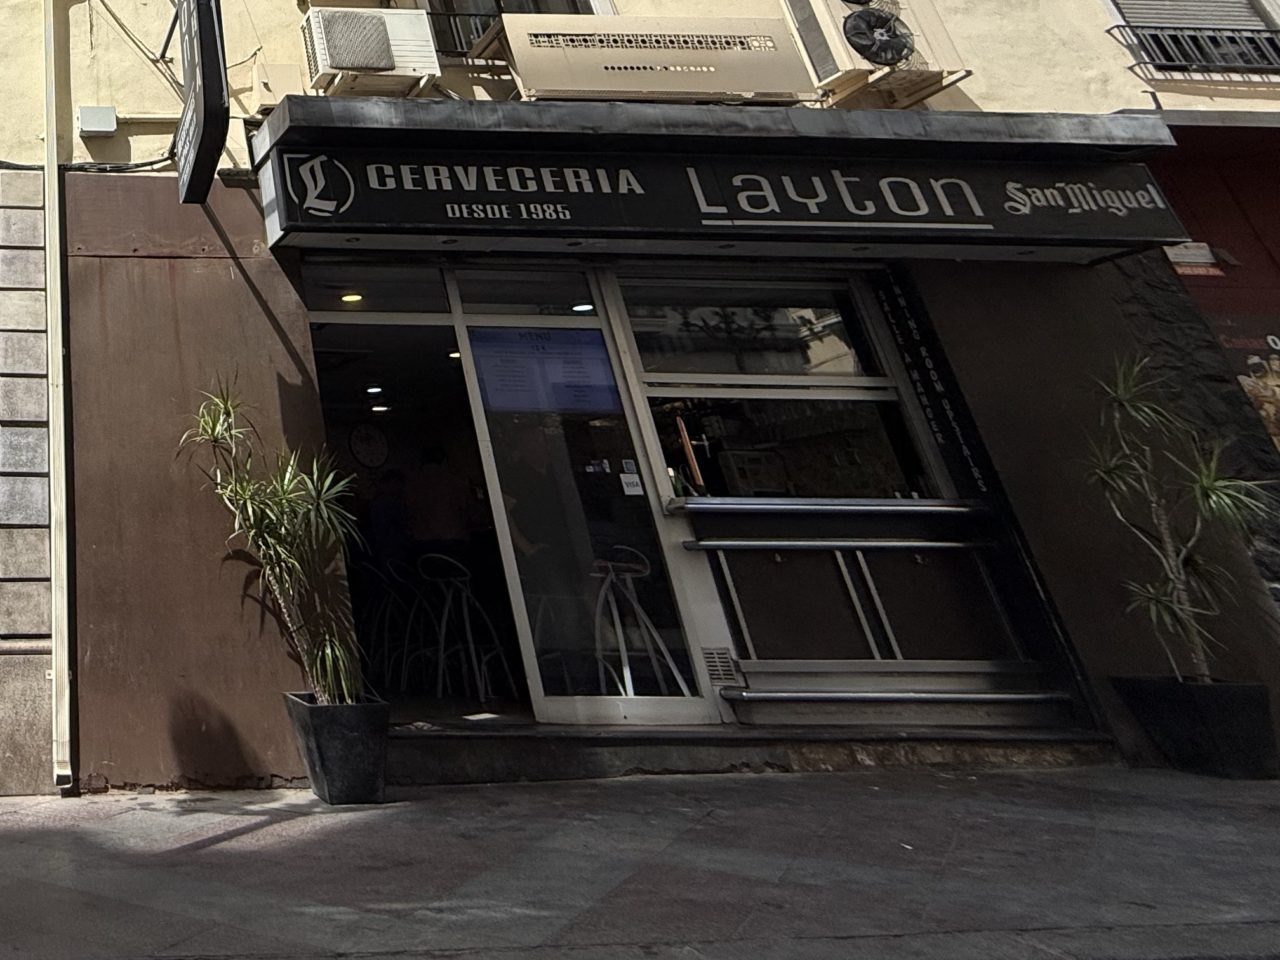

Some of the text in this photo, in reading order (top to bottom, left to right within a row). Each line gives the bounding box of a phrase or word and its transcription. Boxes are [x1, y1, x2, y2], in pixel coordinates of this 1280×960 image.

[366, 163, 645, 195] CERVECERIA
[686, 167, 986, 218] Layton
[446, 203, 571, 221] DESDE 1985
[920, 346, 945, 392] ROOM
